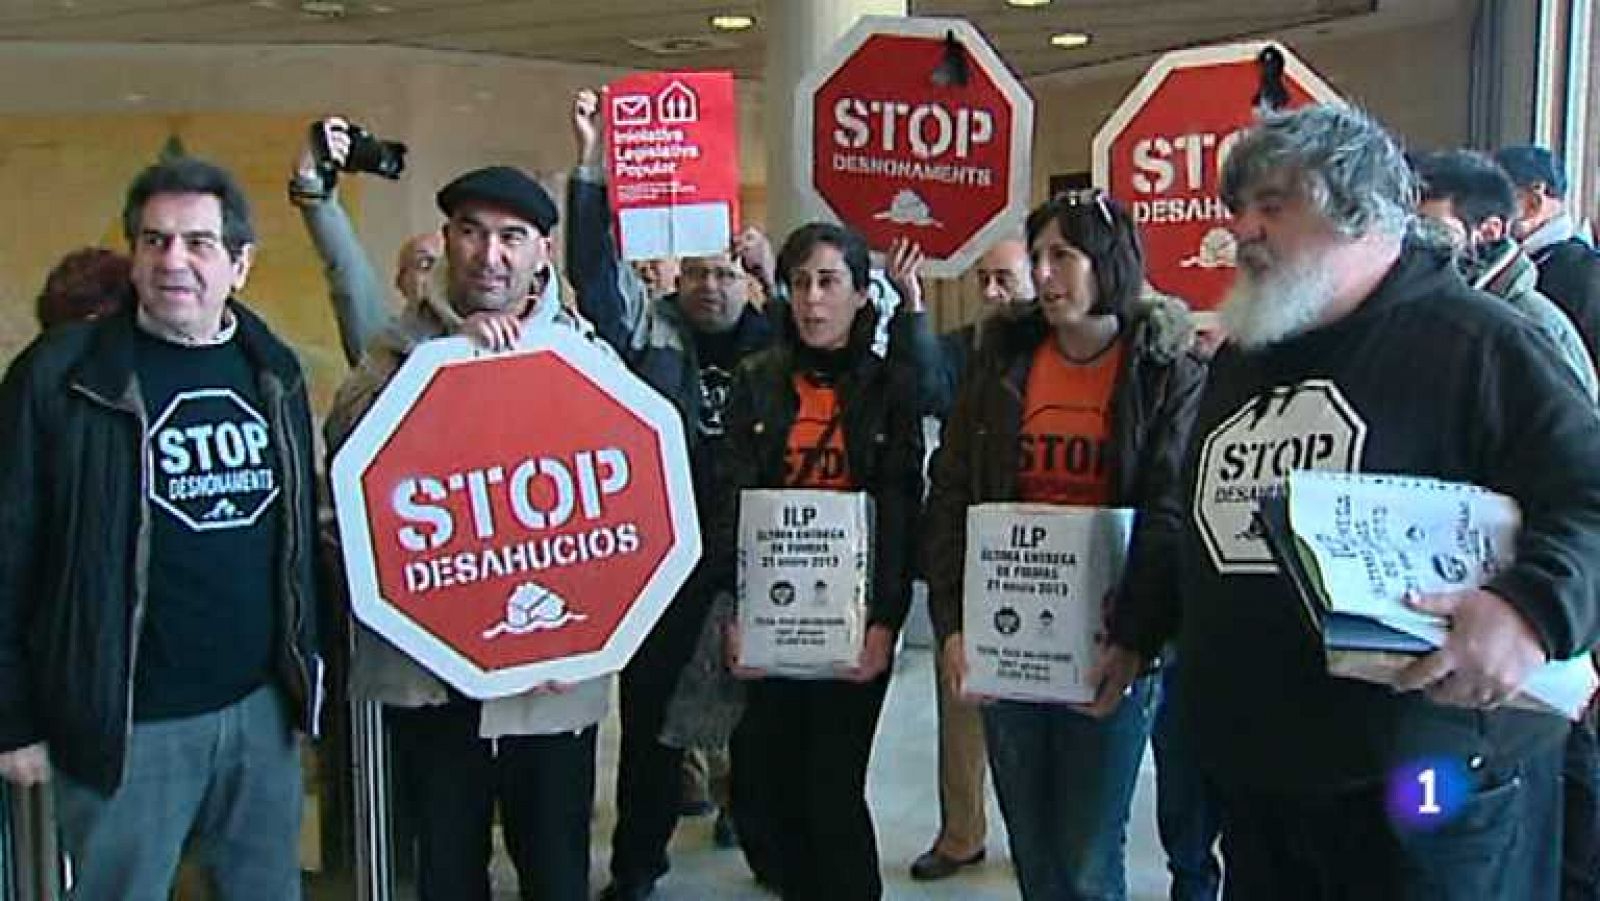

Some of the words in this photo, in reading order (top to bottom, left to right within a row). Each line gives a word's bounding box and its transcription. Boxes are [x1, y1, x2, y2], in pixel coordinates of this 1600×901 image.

[833, 98, 994, 159] STOP
[617, 161, 677, 178] Popular
[832, 153, 992, 186] DESNONAMENTS
[158, 421, 269, 475] STOP
[1220, 433, 1334, 481] STOP
[391, 447, 631, 552] STOP
[782, 506, 818, 527] ILP
[404, 523, 640, 593] DESAHUCIOS
[1010, 524, 1047, 548] ILP
